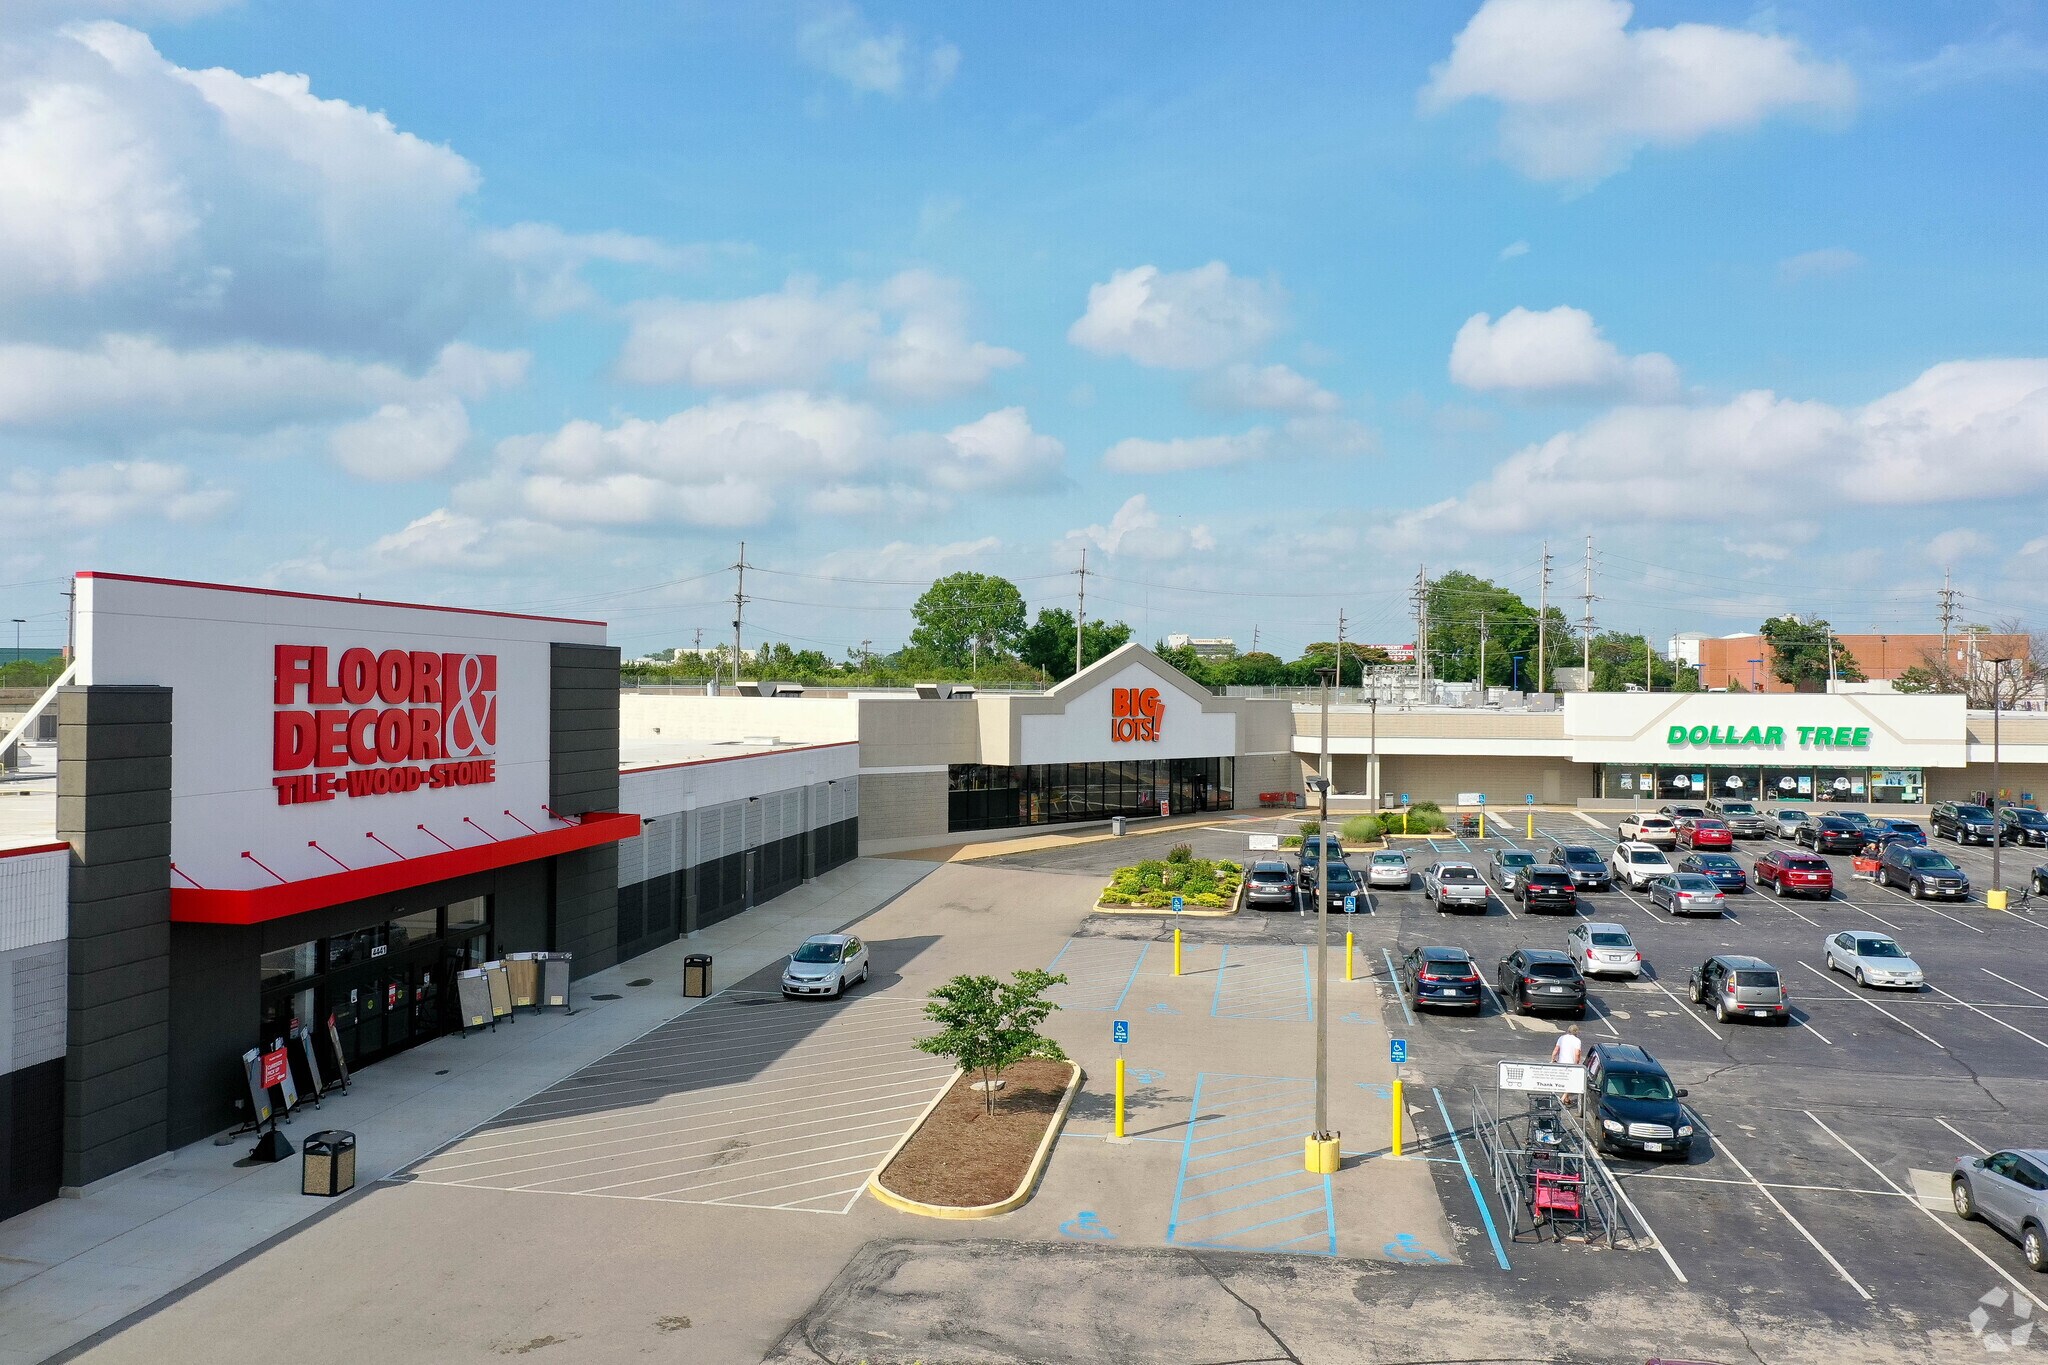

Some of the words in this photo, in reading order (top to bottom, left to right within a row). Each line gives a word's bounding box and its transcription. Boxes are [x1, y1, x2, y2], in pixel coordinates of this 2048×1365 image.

[274, 645, 443, 704] FLOOR
[1112, 687, 1161, 718] BIG
[273, 708, 442, 771] DECOR
[1667, 725, 1784, 745] DOLLAR
[1796, 726, 1870, 746] TREE
